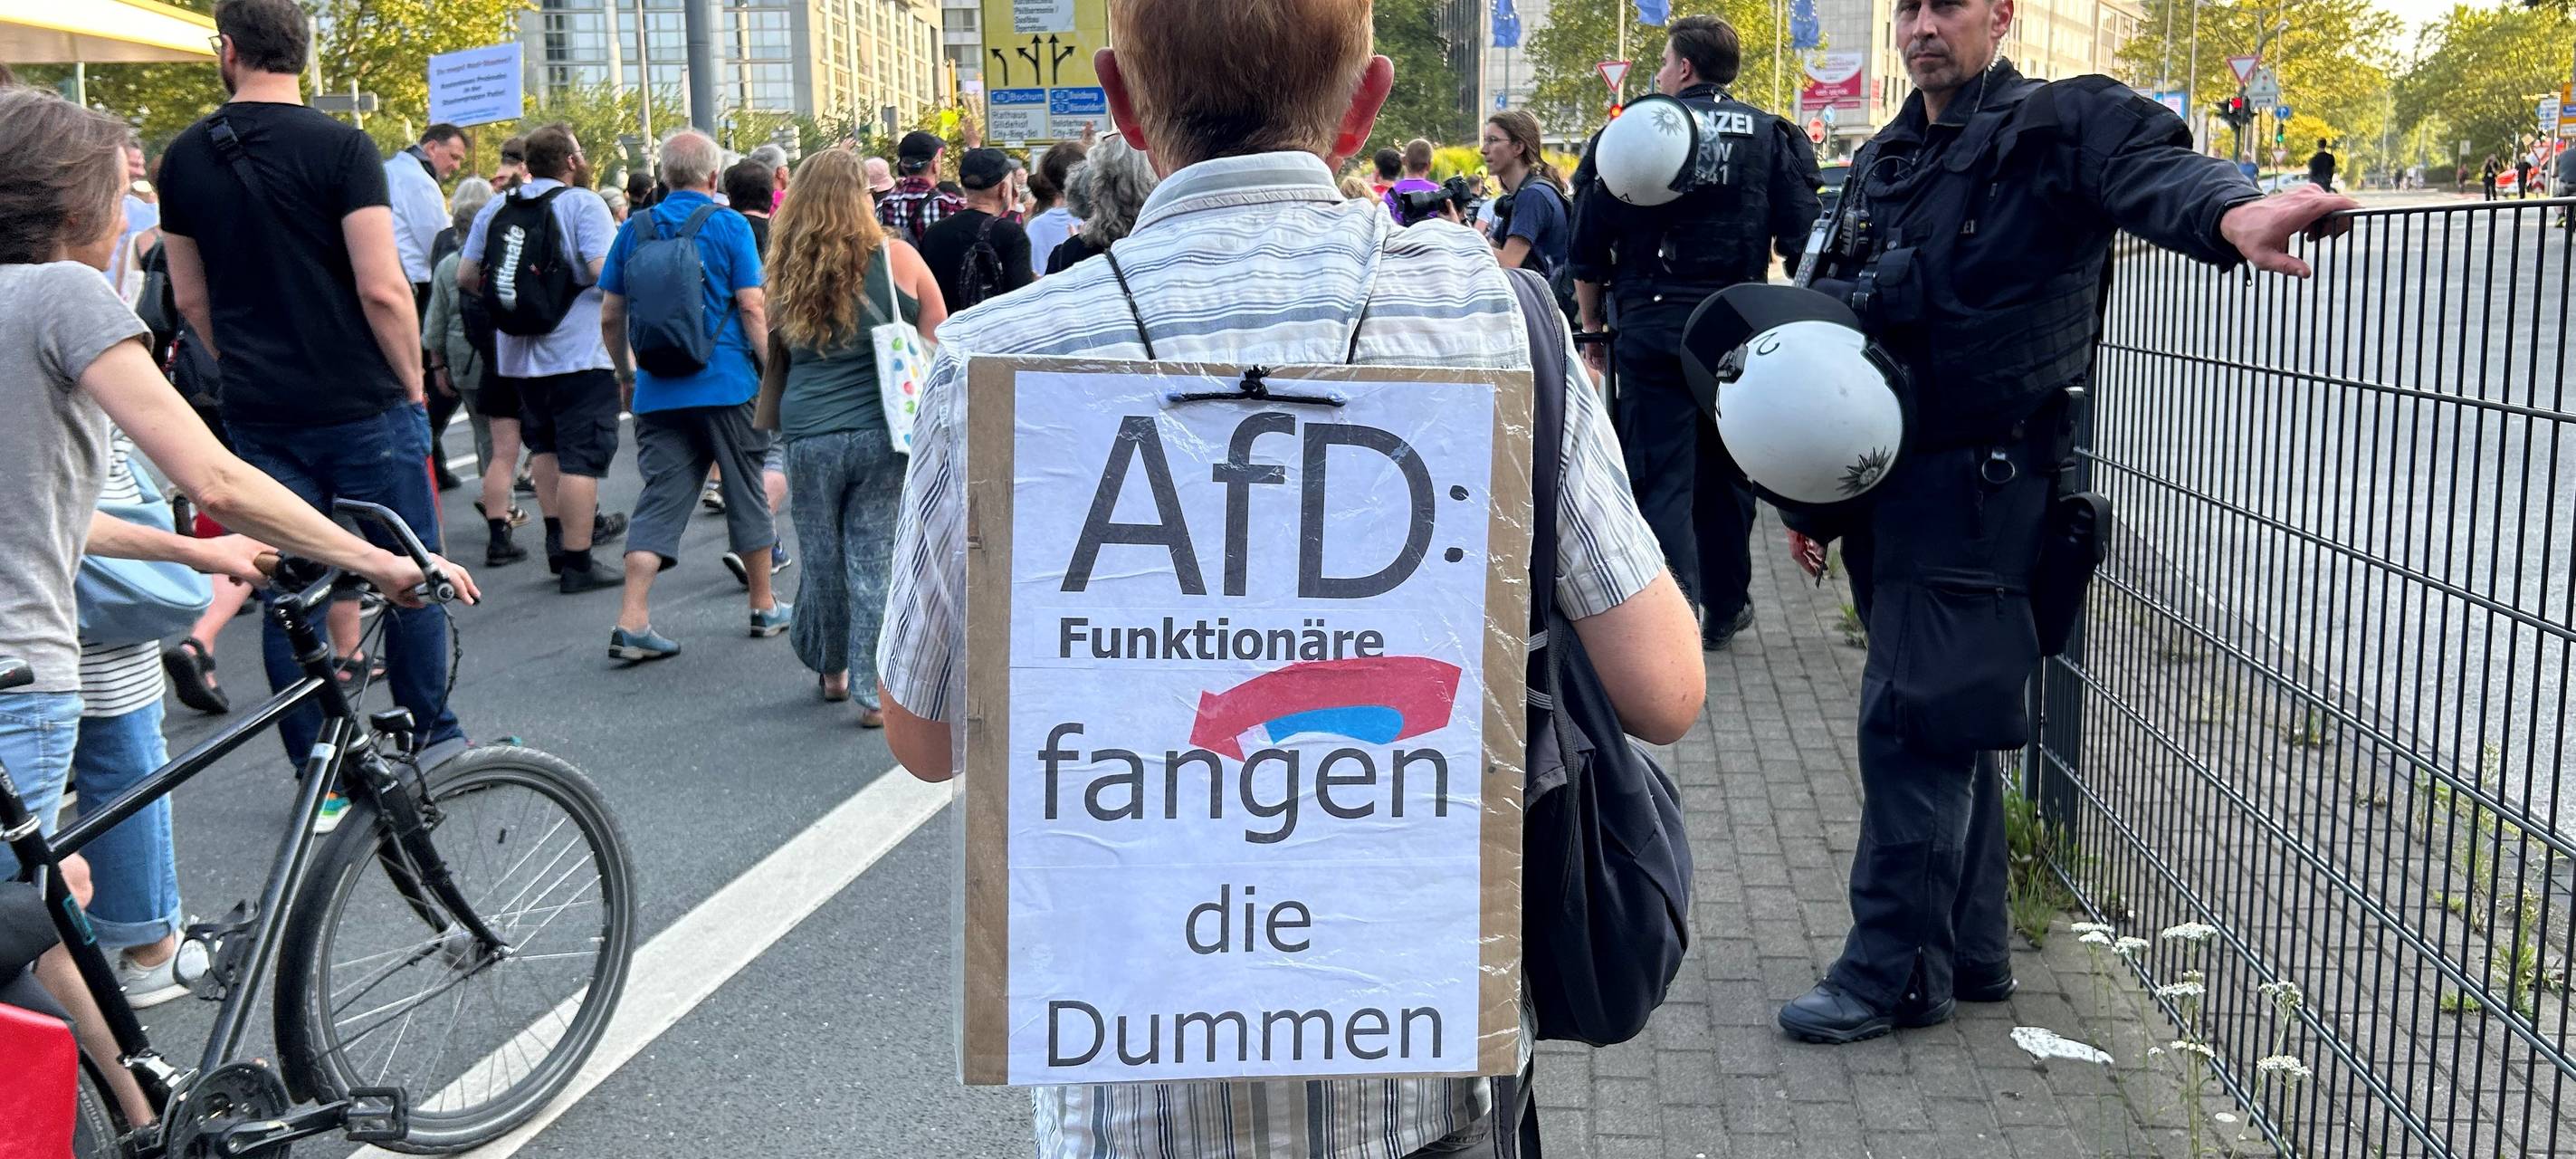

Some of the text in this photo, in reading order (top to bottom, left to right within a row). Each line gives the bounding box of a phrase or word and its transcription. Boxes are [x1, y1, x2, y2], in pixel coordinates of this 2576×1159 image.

[1059, 412, 1471, 599] AfD:
[1059, 617, 1386, 661] Funktionäre
[1037, 722, 1450, 845] fangen
[1184, 883, 1312, 954] die
[1047, 999, 1444, 1068] Dummen
